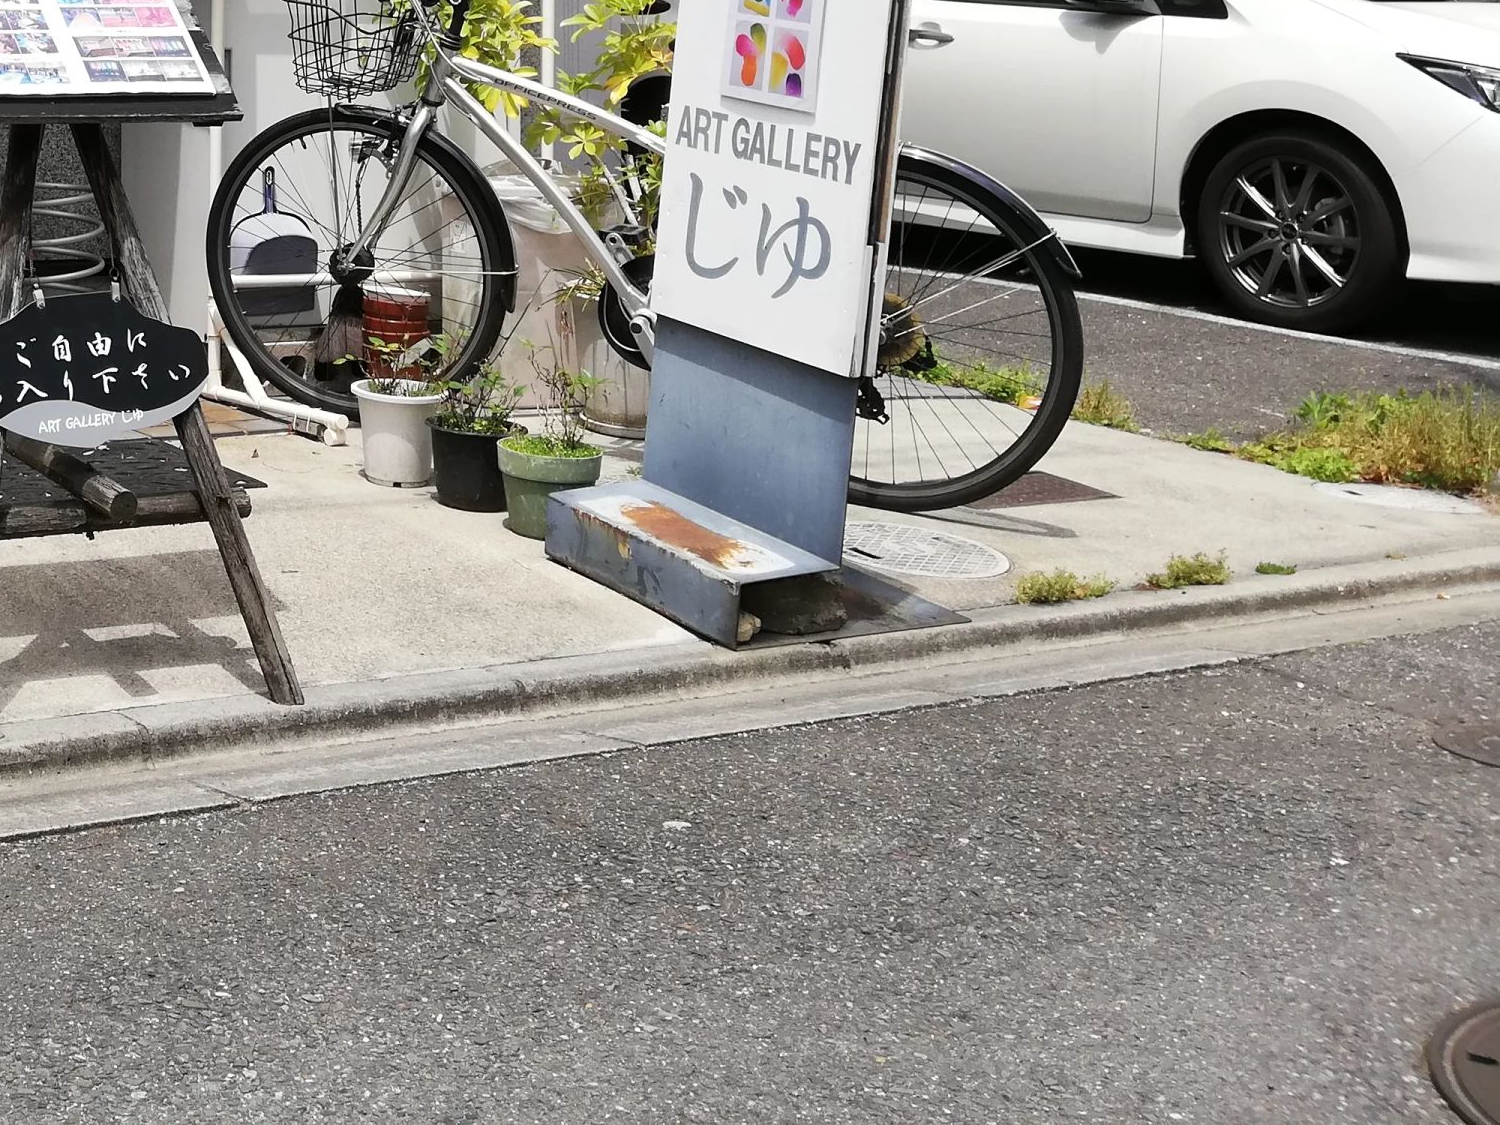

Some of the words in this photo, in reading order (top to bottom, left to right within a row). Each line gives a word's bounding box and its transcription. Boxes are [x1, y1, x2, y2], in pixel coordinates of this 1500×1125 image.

[493, 77, 598, 121] OFFICEPRESS
[674, 104, 729, 154] ART
[731, 117, 862, 186] GALLERY
[16, 328, 147, 369] ご自由に
[38, 418, 60, 434] ART
[65, 412, 117, 429] GALLERY
